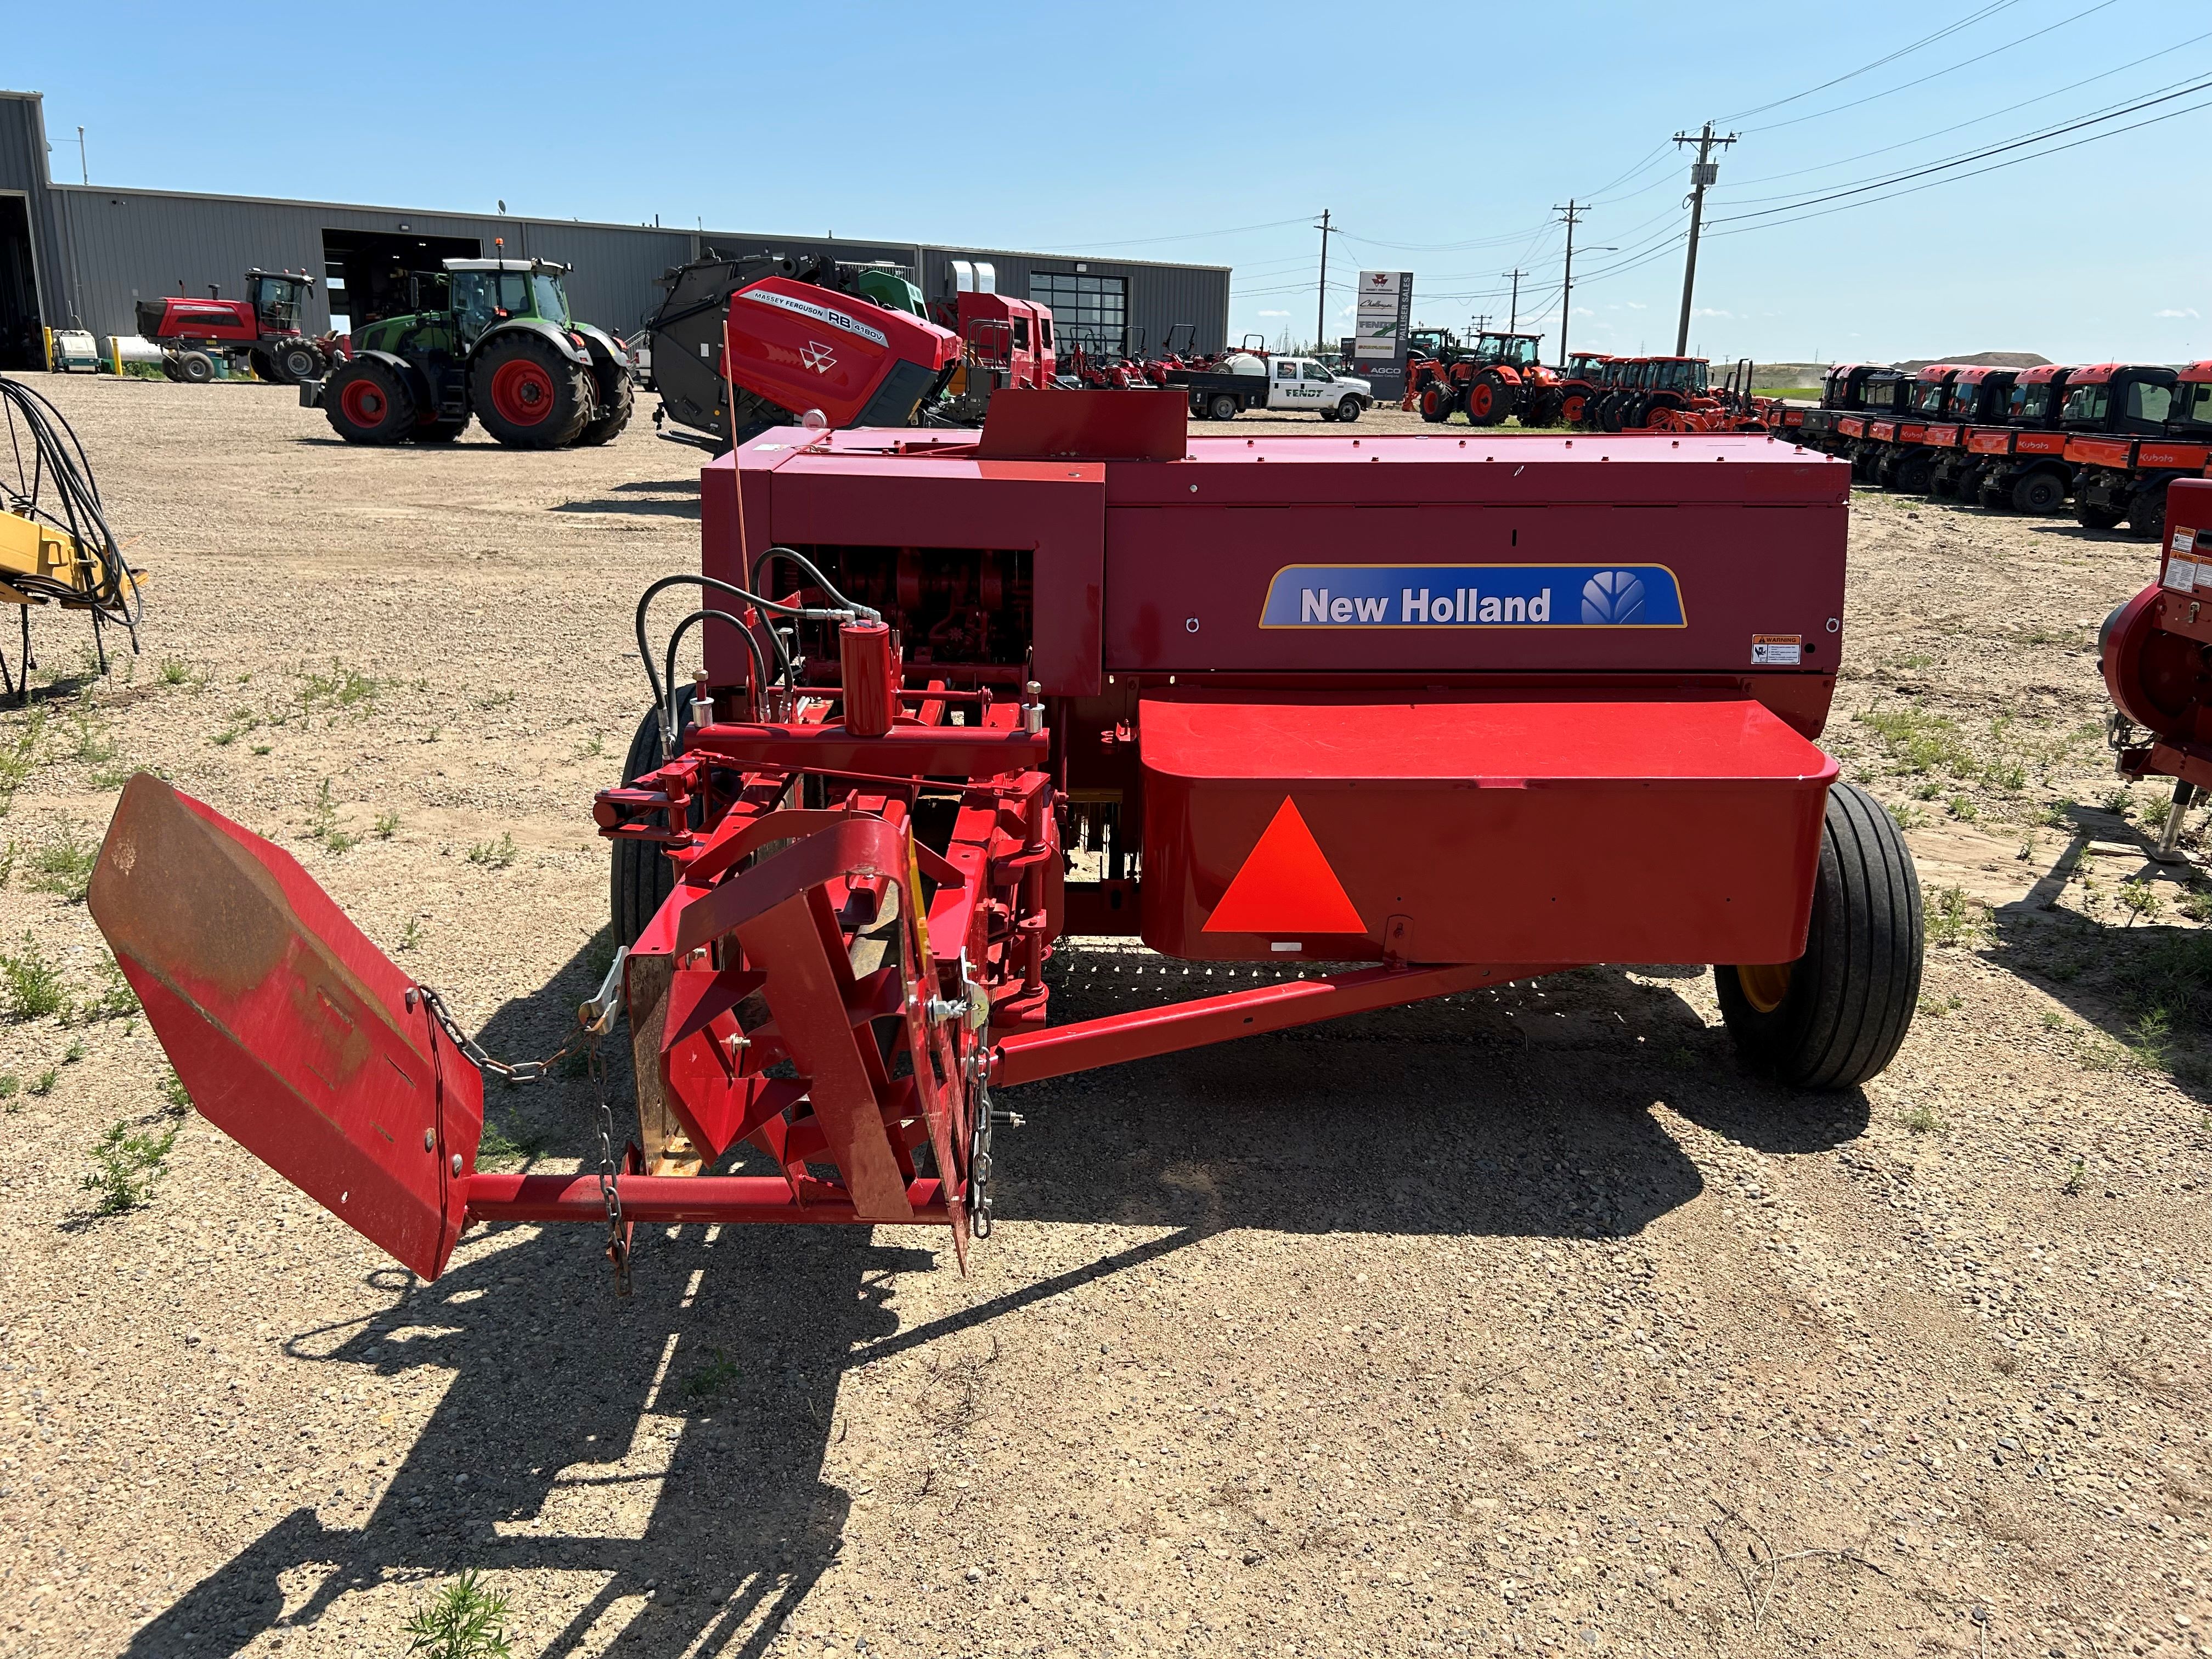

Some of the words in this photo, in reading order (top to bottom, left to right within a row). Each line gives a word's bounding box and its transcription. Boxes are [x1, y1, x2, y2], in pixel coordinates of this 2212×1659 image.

[1402, 276, 1410, 303] SALES
[754, 292, 784, 304] MASSEY
[785, 300, 823, 317] FERGUSON
[828, 311, 850, 329] RB
[854, 324, 883, 341] 4180V
[1399, 304, 1408, 341] PALLISER
[1285, 389, 1324, 397] FENDT
[2018, 441, 2049, 450] Kubota
[2140, 453, 2173, 462] Kubota
[1301, 588, 1389, 623] New
[1401, 588, 1551, 623] Holland
